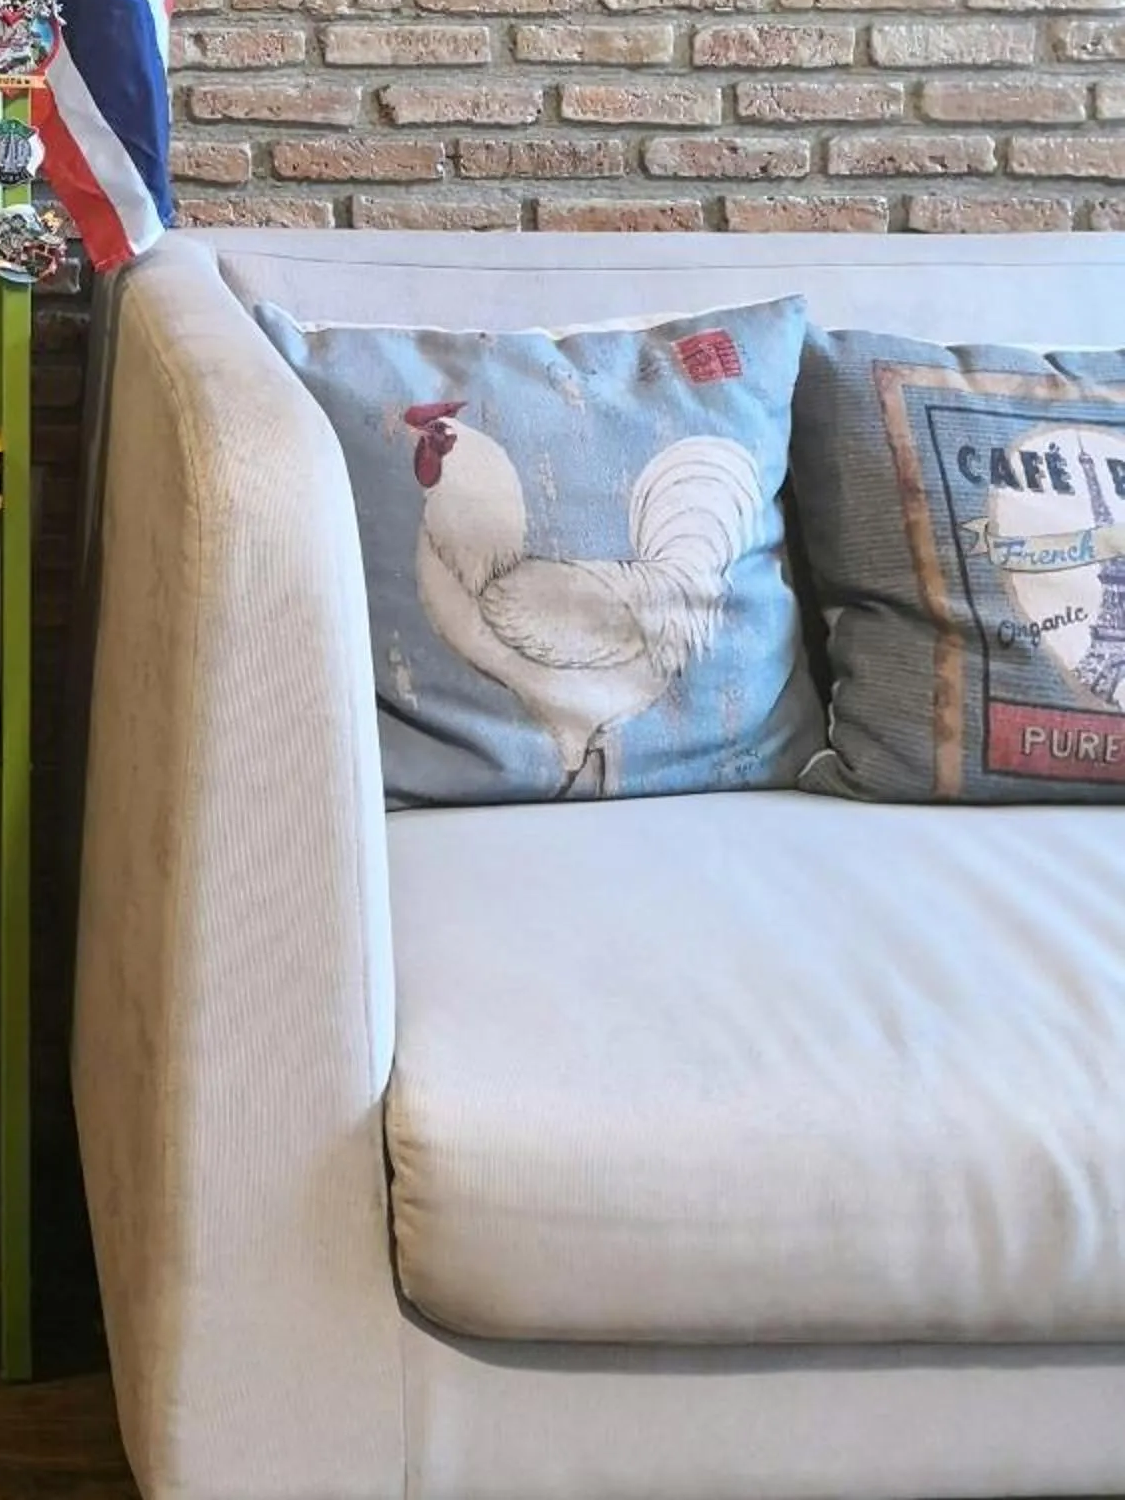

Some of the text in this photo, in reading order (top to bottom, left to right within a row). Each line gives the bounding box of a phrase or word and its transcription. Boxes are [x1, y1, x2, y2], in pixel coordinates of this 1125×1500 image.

[957, 442, 1076, 495] CAFÉ
[993, 530, 1096, 566] French
[997, 605, 1089, 649] Organic
[1021, 726, 1125, 765] PURE
